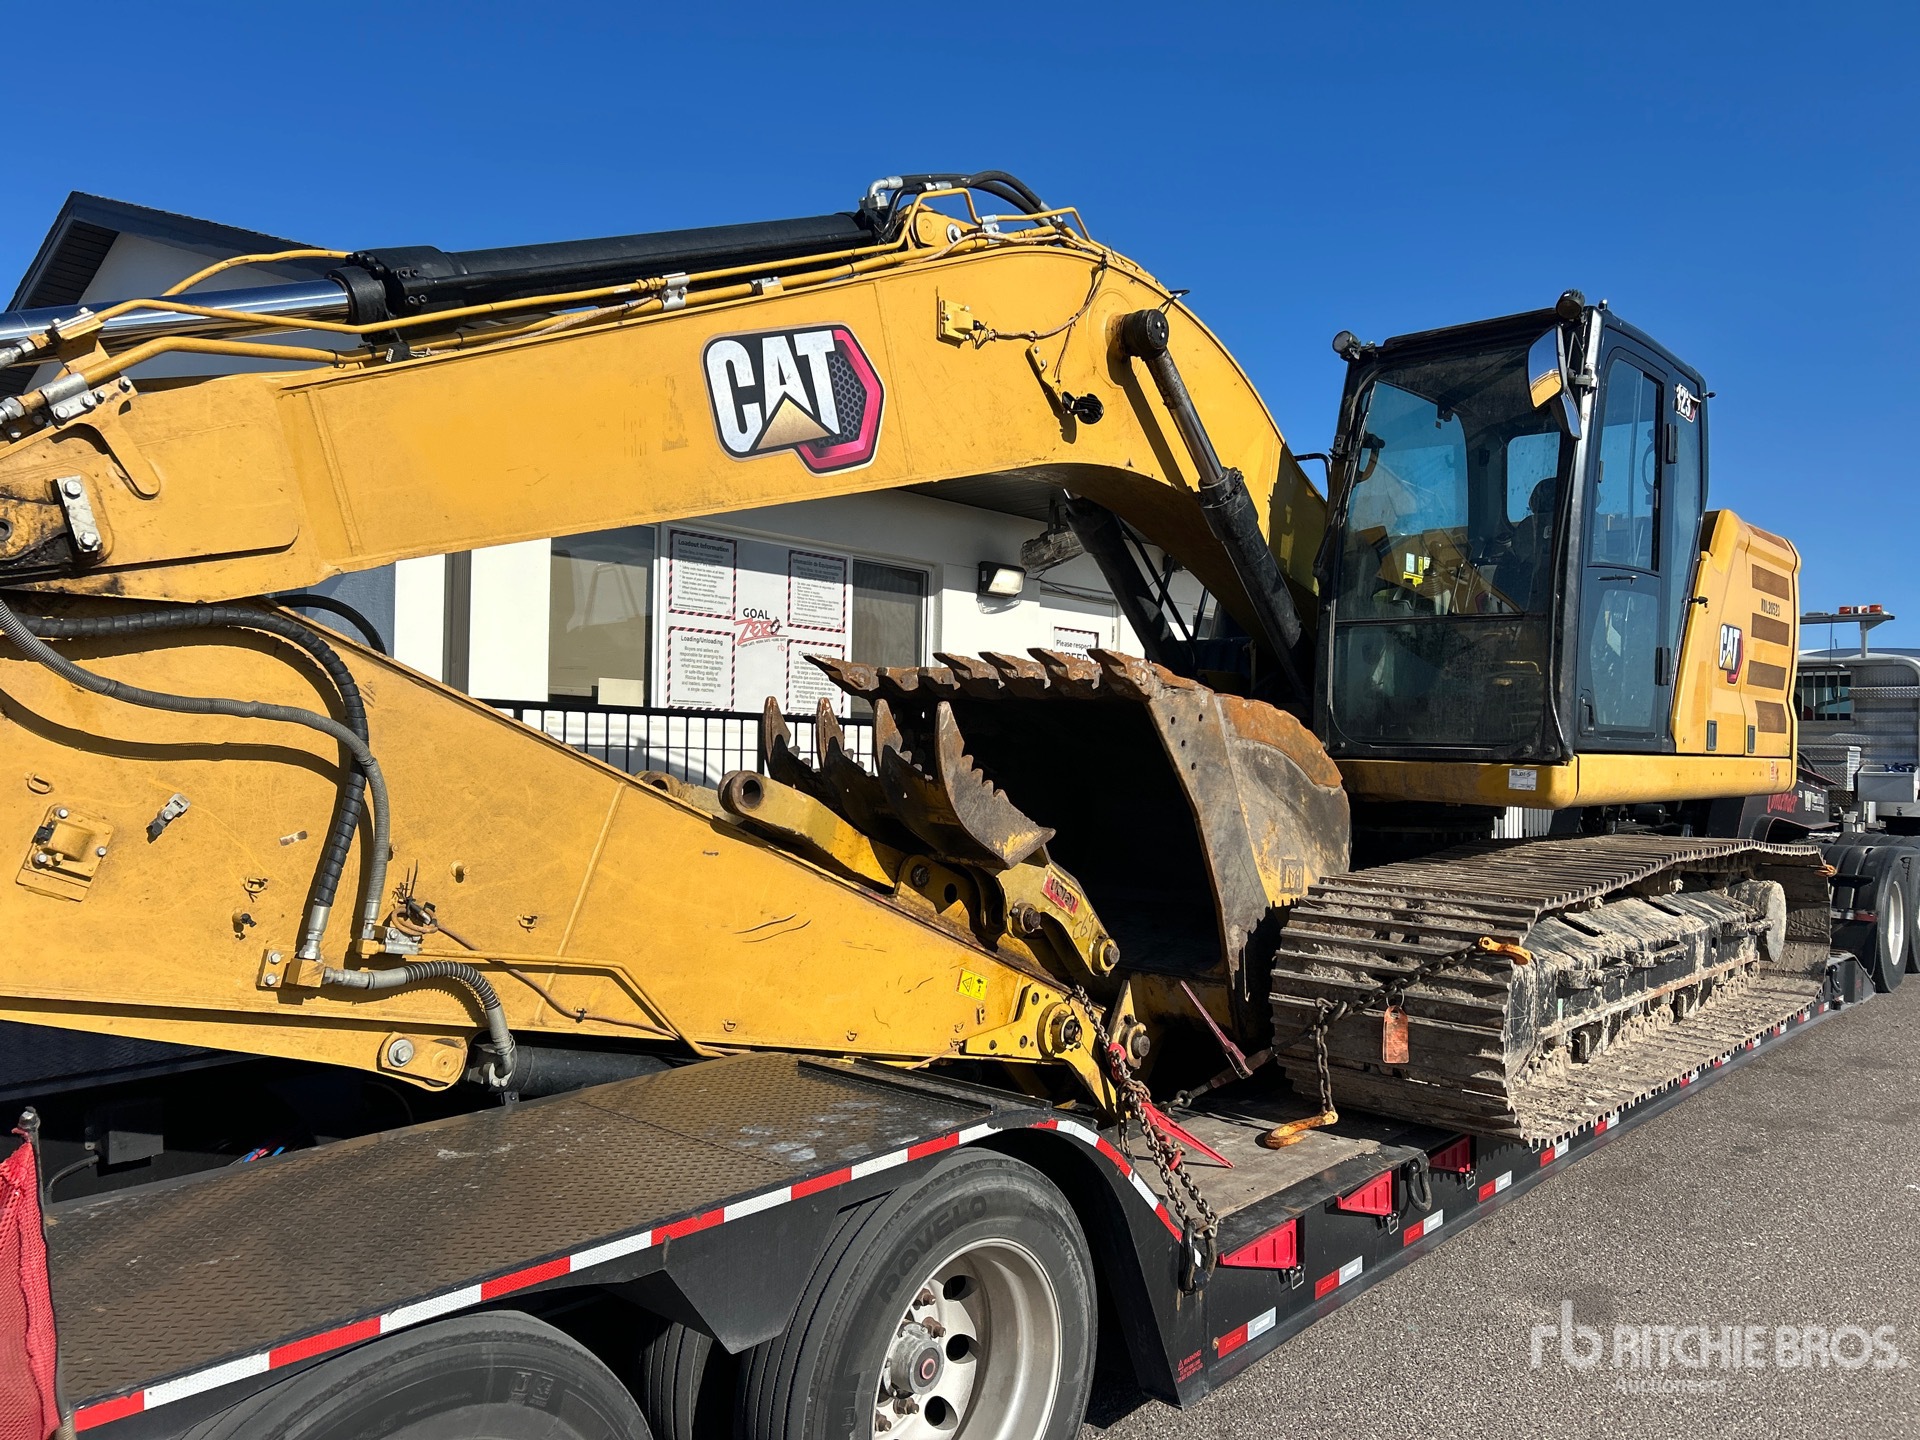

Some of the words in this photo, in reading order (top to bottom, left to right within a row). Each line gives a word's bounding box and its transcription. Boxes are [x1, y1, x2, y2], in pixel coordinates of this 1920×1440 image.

[707, 330, 840, 453] CAT
[700, 542, 729, 552] Information
[743, 608, 770, 620] GOAL
[681, 636, 723, 646] Loading/Unloading
[1719, 624, 1740, 670] CAT
[880, 1196, 987, 1304] ROVELO
